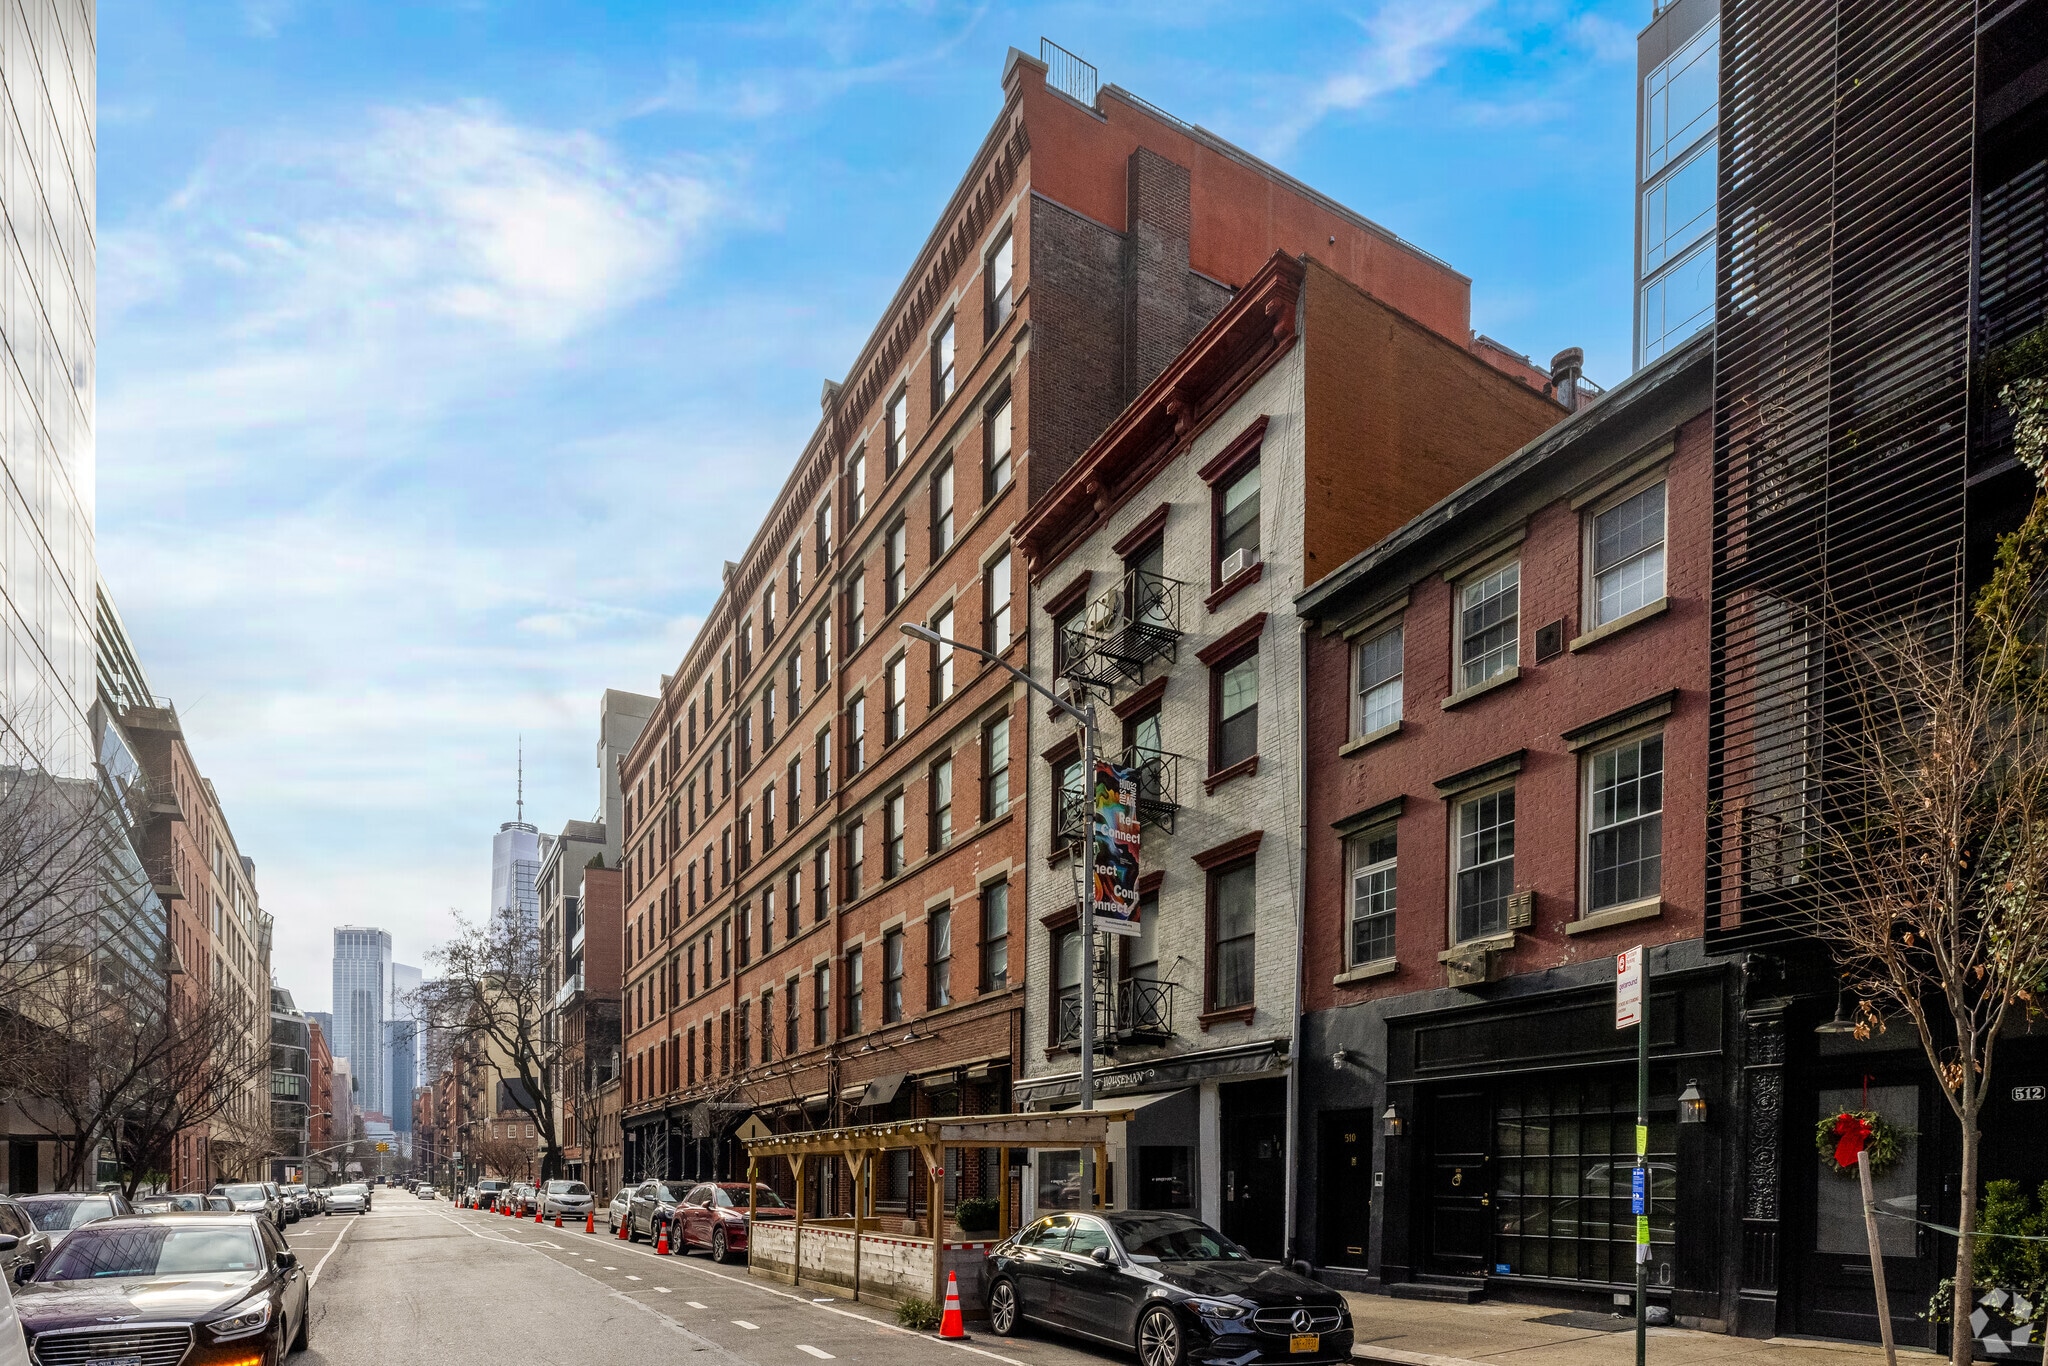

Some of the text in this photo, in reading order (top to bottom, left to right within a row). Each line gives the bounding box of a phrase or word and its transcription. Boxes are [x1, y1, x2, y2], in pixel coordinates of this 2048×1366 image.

[1113, 884, 1139, 900] Conn
[1103, 1071, 1145, 1087] HOUSEMAN
[2015, 1087, 2042, 1100] 512
[1344, 1133, 1356, 1142] 510
